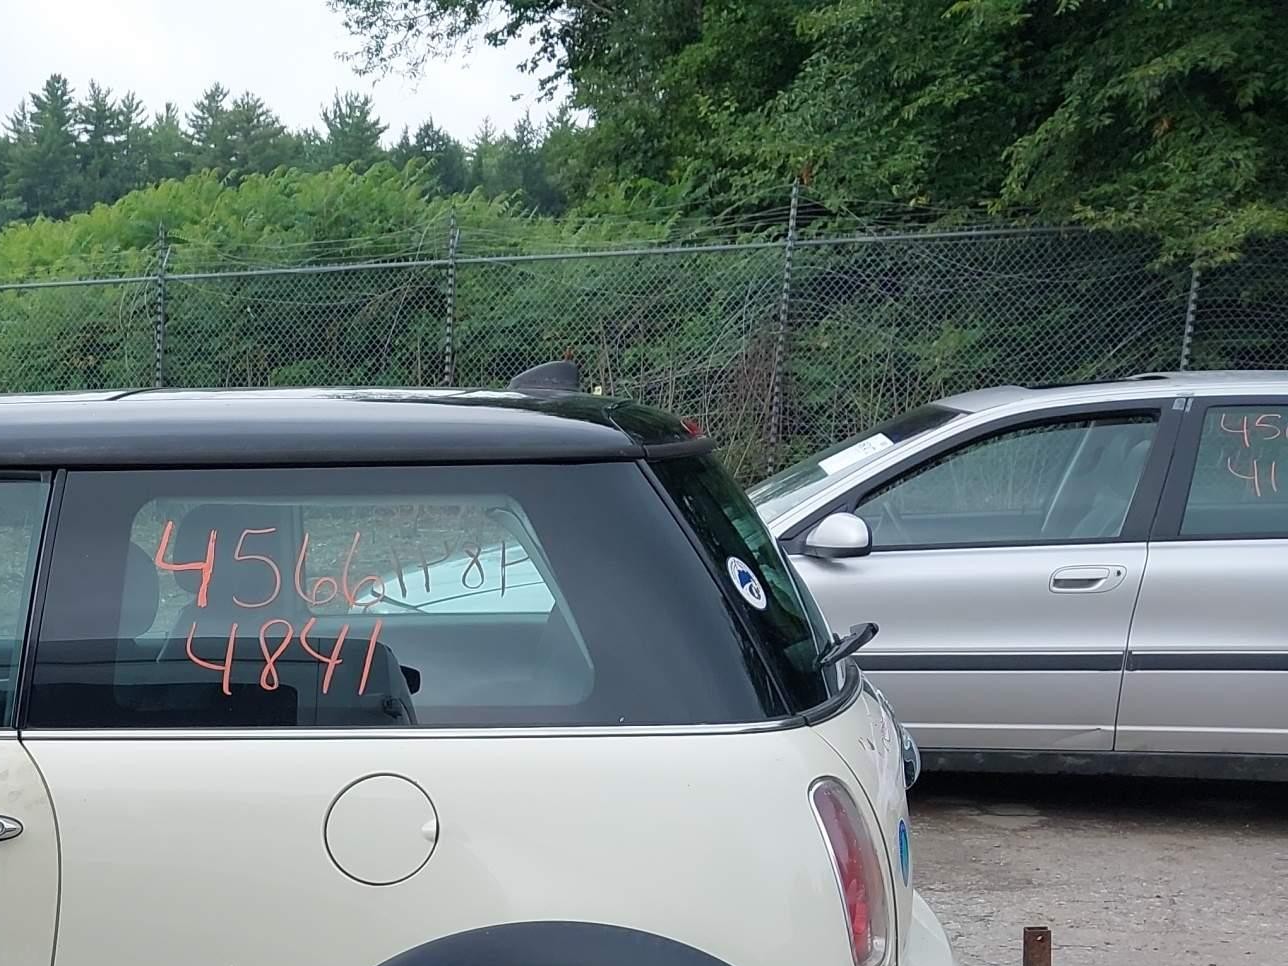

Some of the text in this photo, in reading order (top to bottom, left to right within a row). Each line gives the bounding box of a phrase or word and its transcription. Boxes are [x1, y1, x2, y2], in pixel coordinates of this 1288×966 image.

[1220, 413, 1288, 449] 45
[155, 520, 385, 608] 4566
[187, 617, 383, 696] 4841
